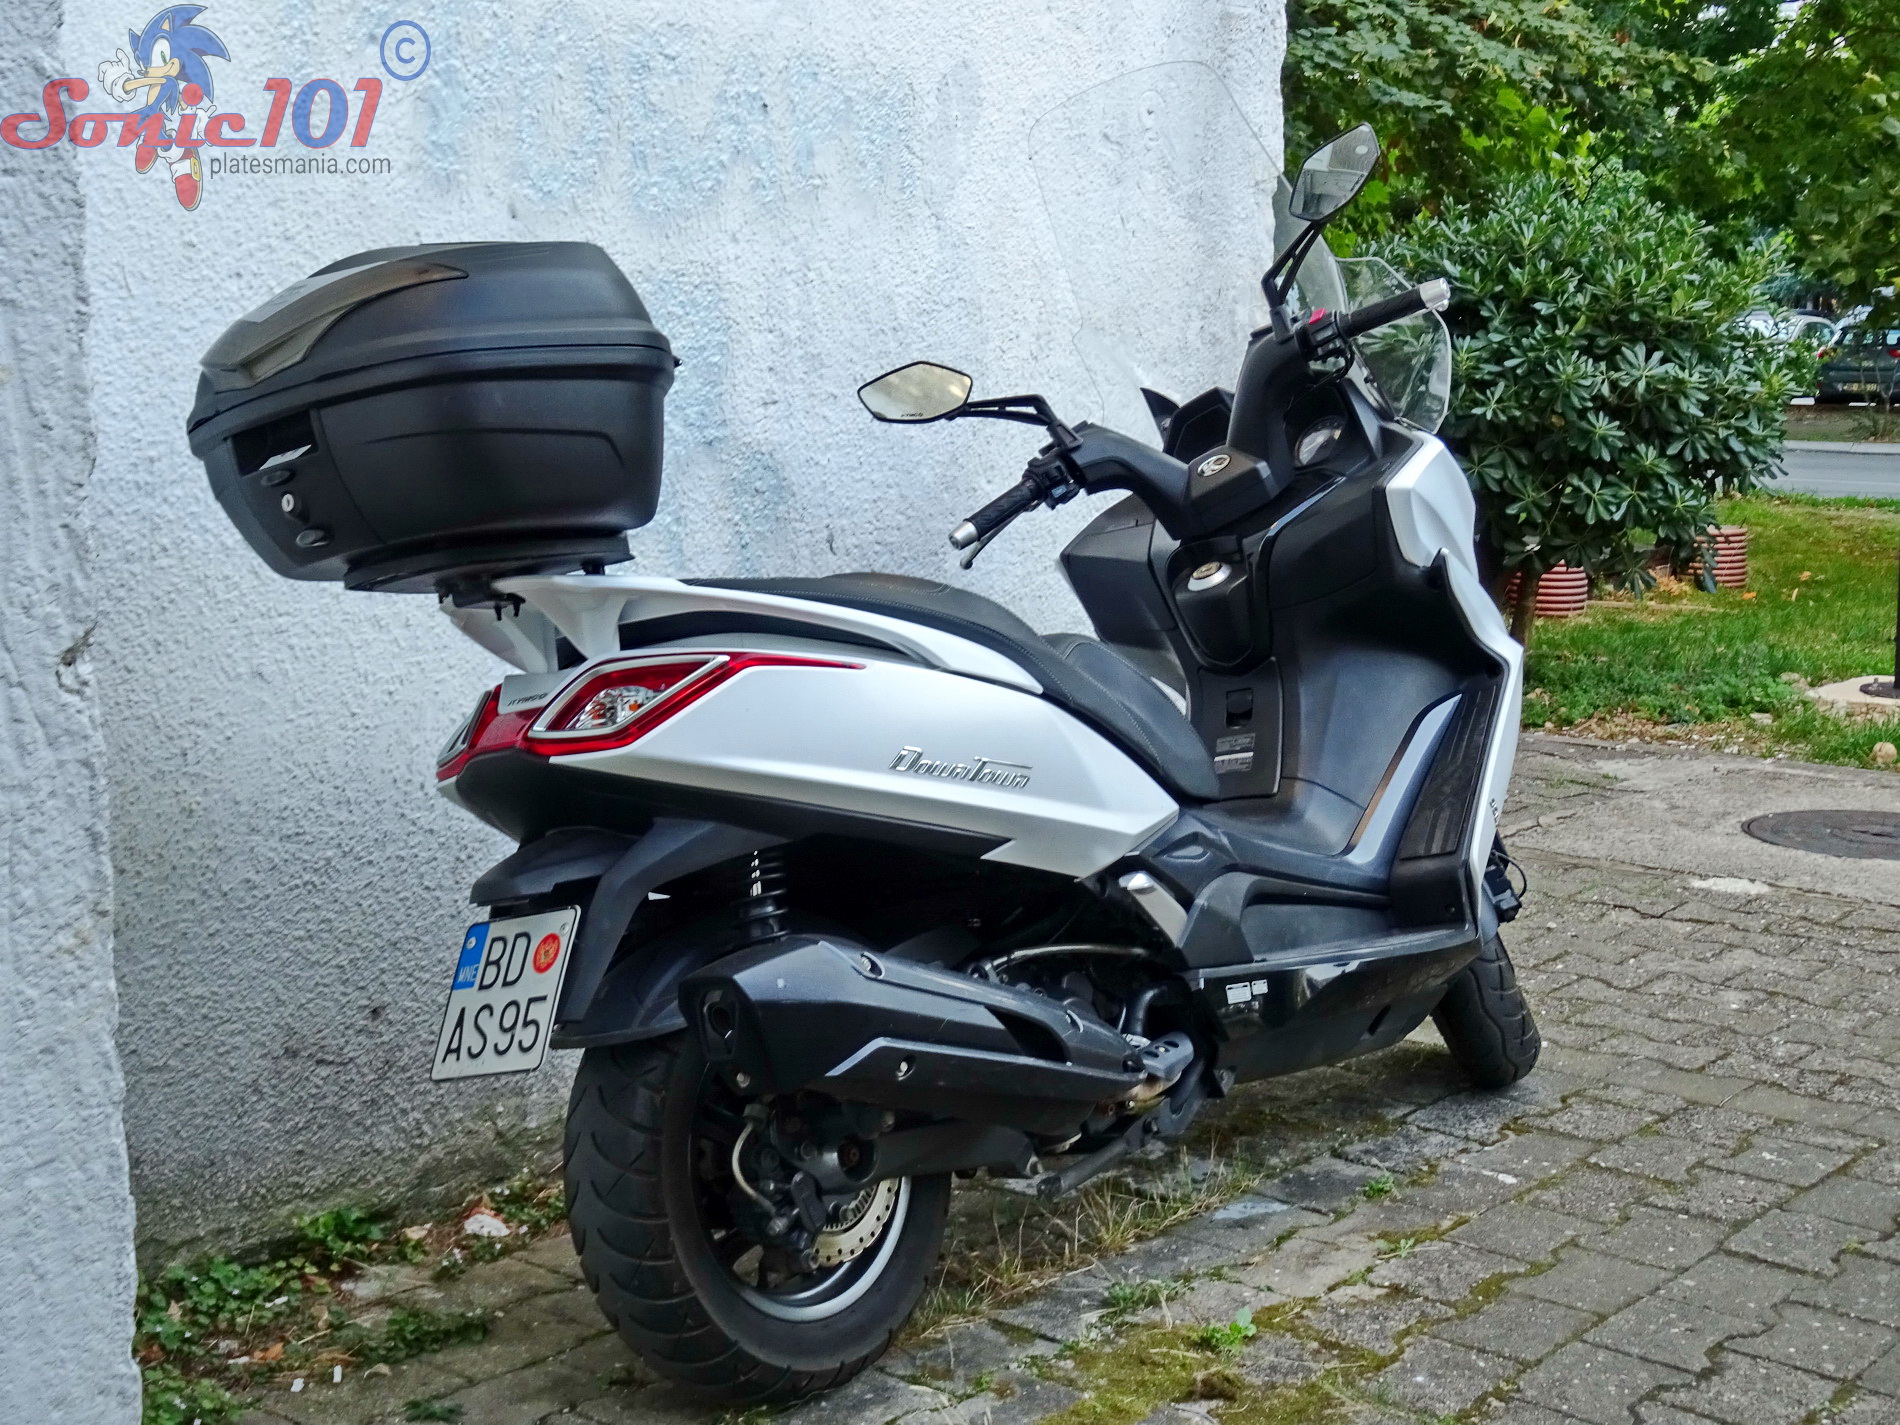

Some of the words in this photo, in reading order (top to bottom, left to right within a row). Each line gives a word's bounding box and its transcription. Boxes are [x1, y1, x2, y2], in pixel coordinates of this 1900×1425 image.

[458, 963, 479, 983] MNE
[477, 931, 532, 991] BD
[441, 994, 549, 1063] AS95
